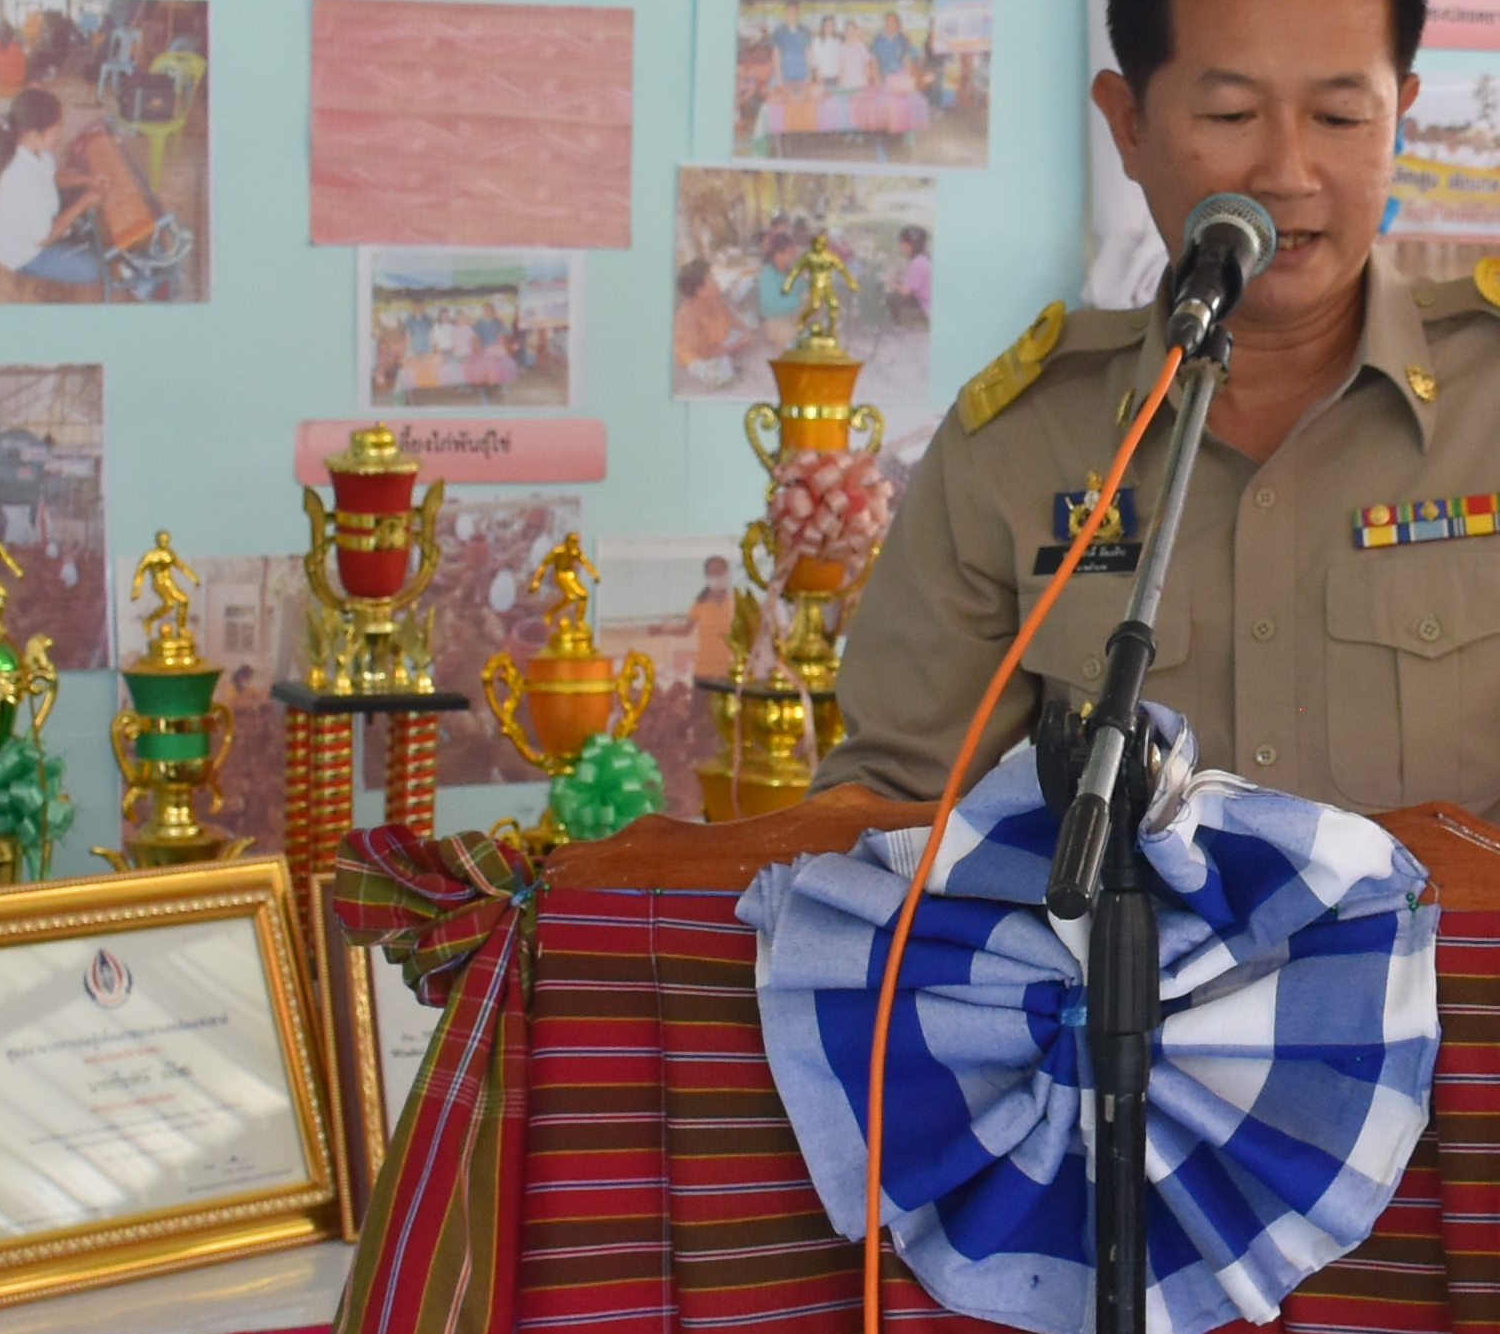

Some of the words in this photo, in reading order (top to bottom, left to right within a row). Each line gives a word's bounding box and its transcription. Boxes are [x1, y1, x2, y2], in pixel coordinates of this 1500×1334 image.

[399, 425, 511, 459] ลี้ยงไก่พันธุ์ไข่
